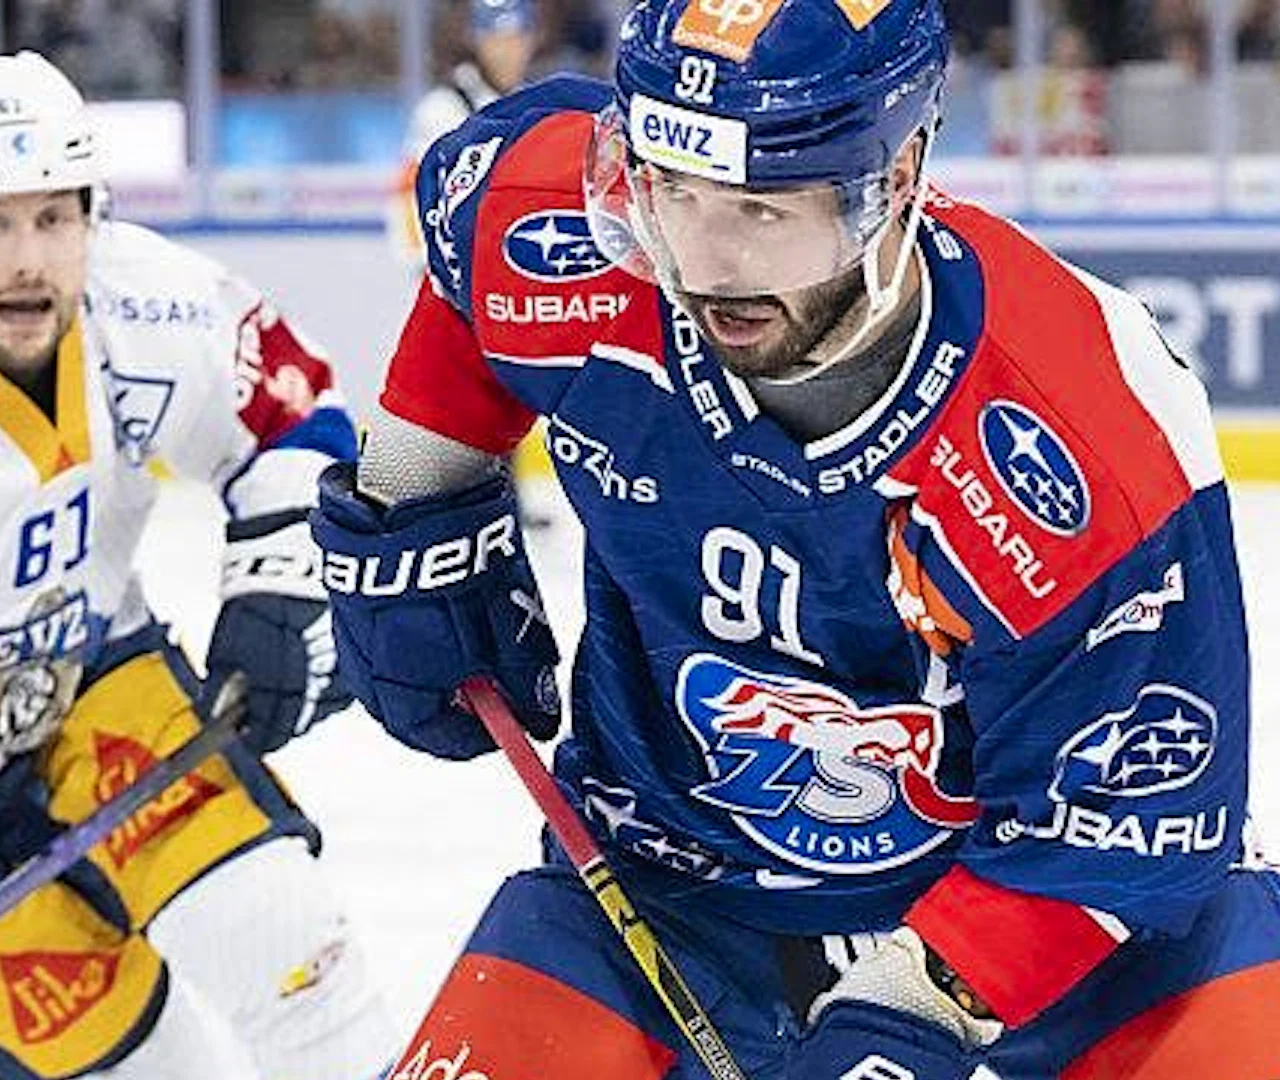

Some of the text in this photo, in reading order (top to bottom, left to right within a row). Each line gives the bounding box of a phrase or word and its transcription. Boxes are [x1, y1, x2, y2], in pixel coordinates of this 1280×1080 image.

[675, 56, 717, 104] 91
[642, 113, 713, 157] ewz
[818, 340, 966, 496] STADLER
[730, 452, 813, 498] STADLER
[14, 486, 90, 588] 61
[930, 435, 1059, 600] SUBARU
[700, 526, 825, 667] 91
[785, 825, 896, 858] LIONS
